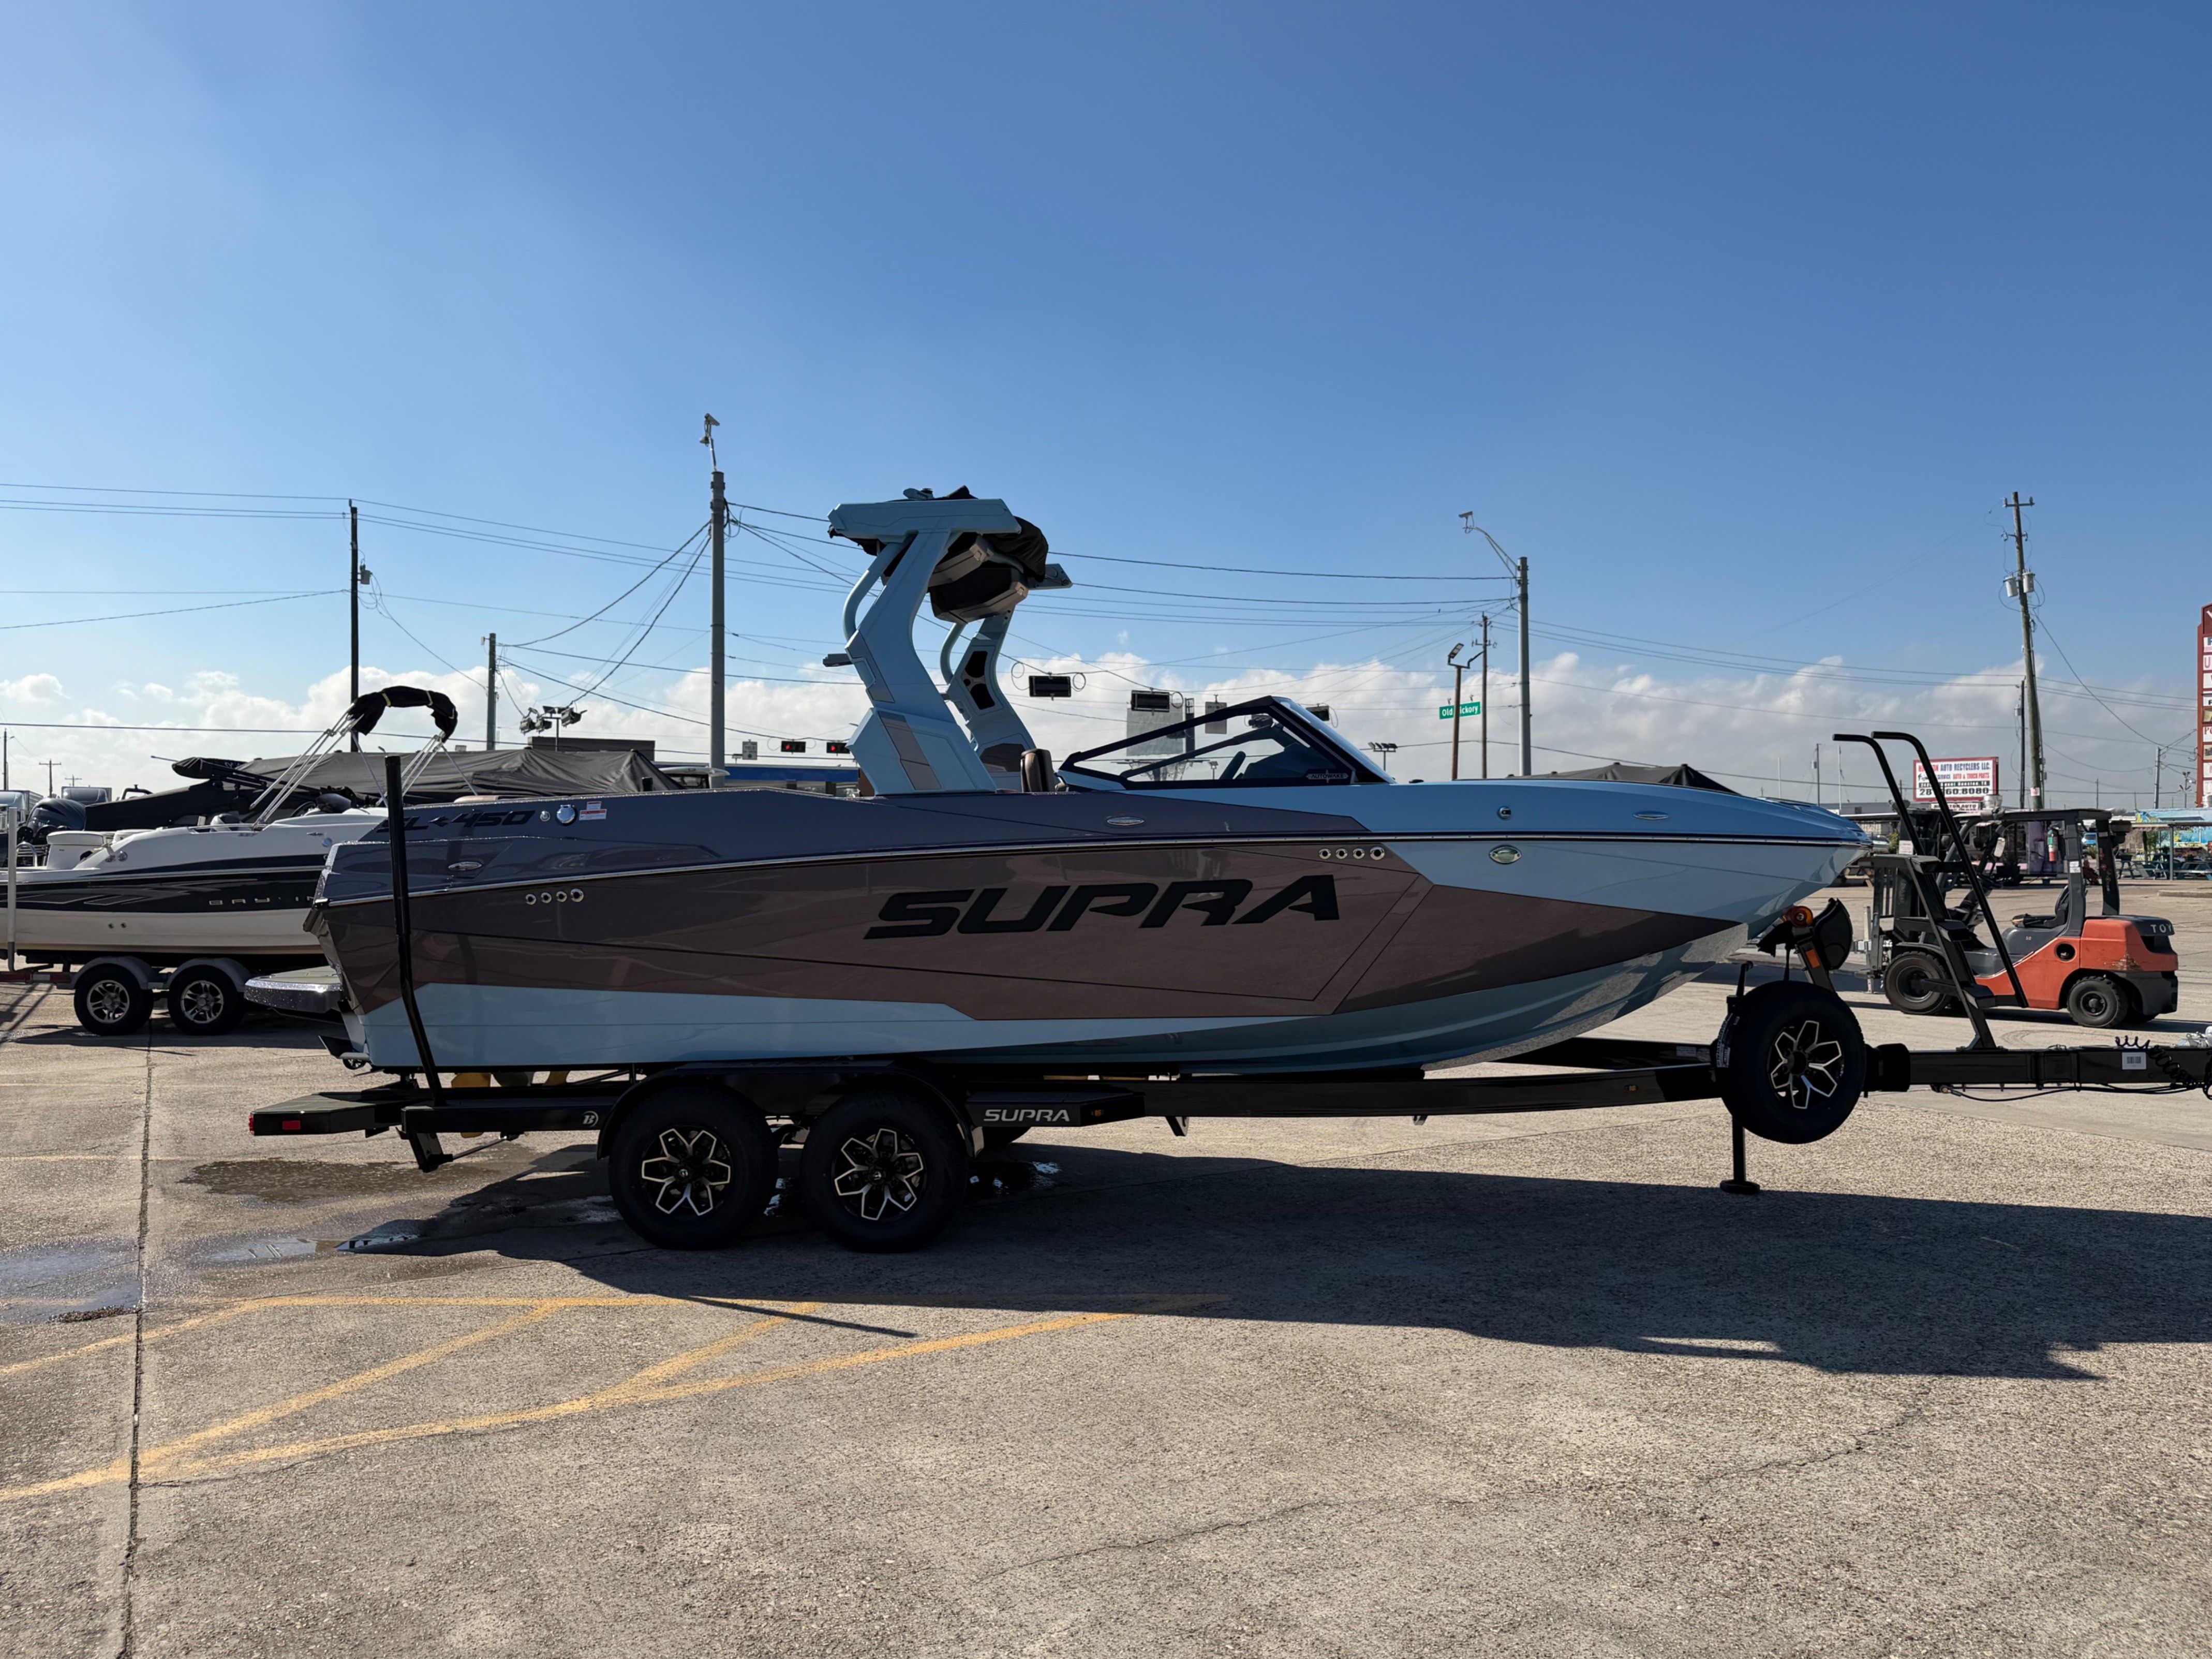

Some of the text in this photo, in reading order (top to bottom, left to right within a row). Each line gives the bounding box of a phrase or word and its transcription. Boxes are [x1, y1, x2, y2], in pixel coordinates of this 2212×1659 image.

[1442, 705, 1478, 717] Old ickory
[1954, 763, 1980, 771] RECYCLERS
[451, 809, 536, 828] 450
[863, 874, 1340, 940] SUPRA
[984, 1109, 1070, 1122] SUPRA
